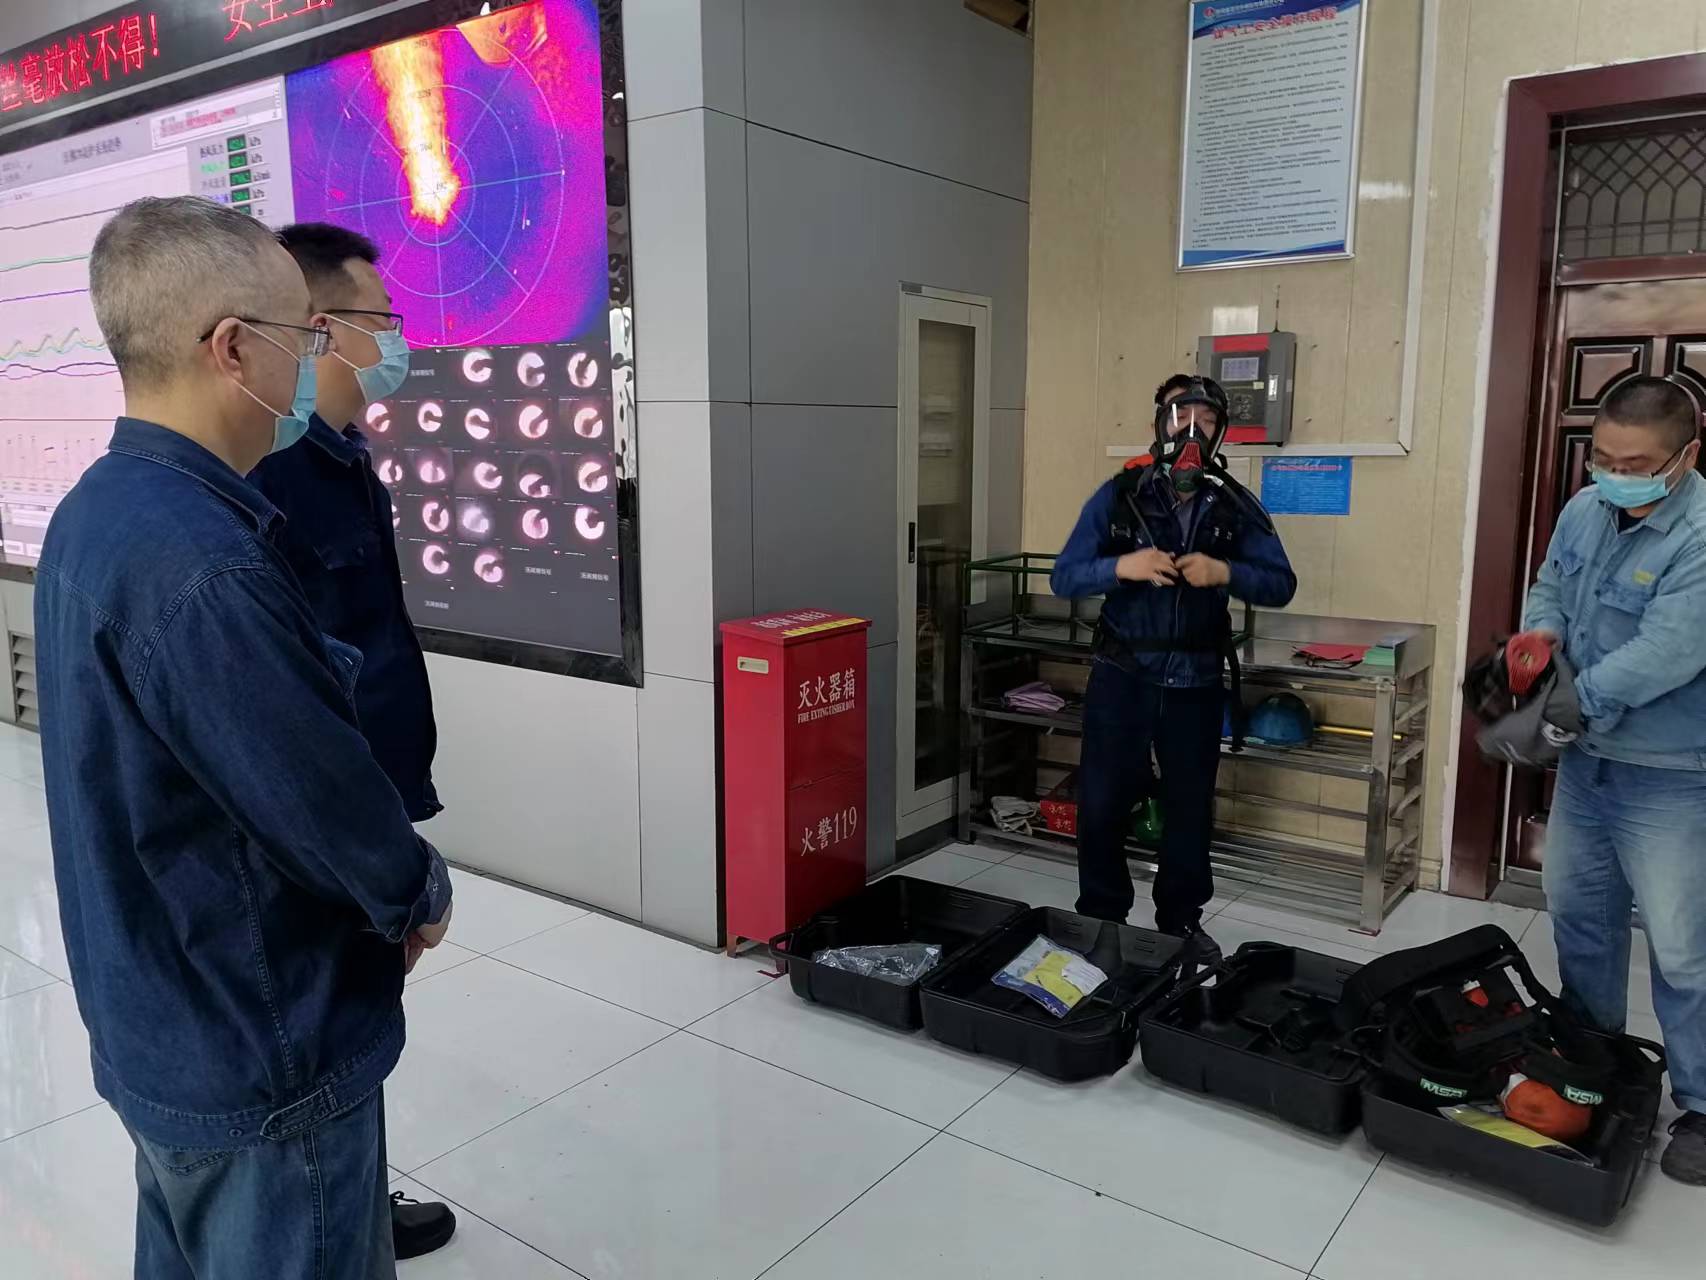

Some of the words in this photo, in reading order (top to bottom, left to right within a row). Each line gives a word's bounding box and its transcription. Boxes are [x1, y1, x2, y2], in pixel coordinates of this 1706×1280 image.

[797, 667, 856, 709] 灭火器箱
[797, 711, 810, 724] FIRE
[800, 805, 858, 857] 火警119
[1421, 1080, 1464, 1098] MSA
[1566, 1087, 1603, 1106] MSA
